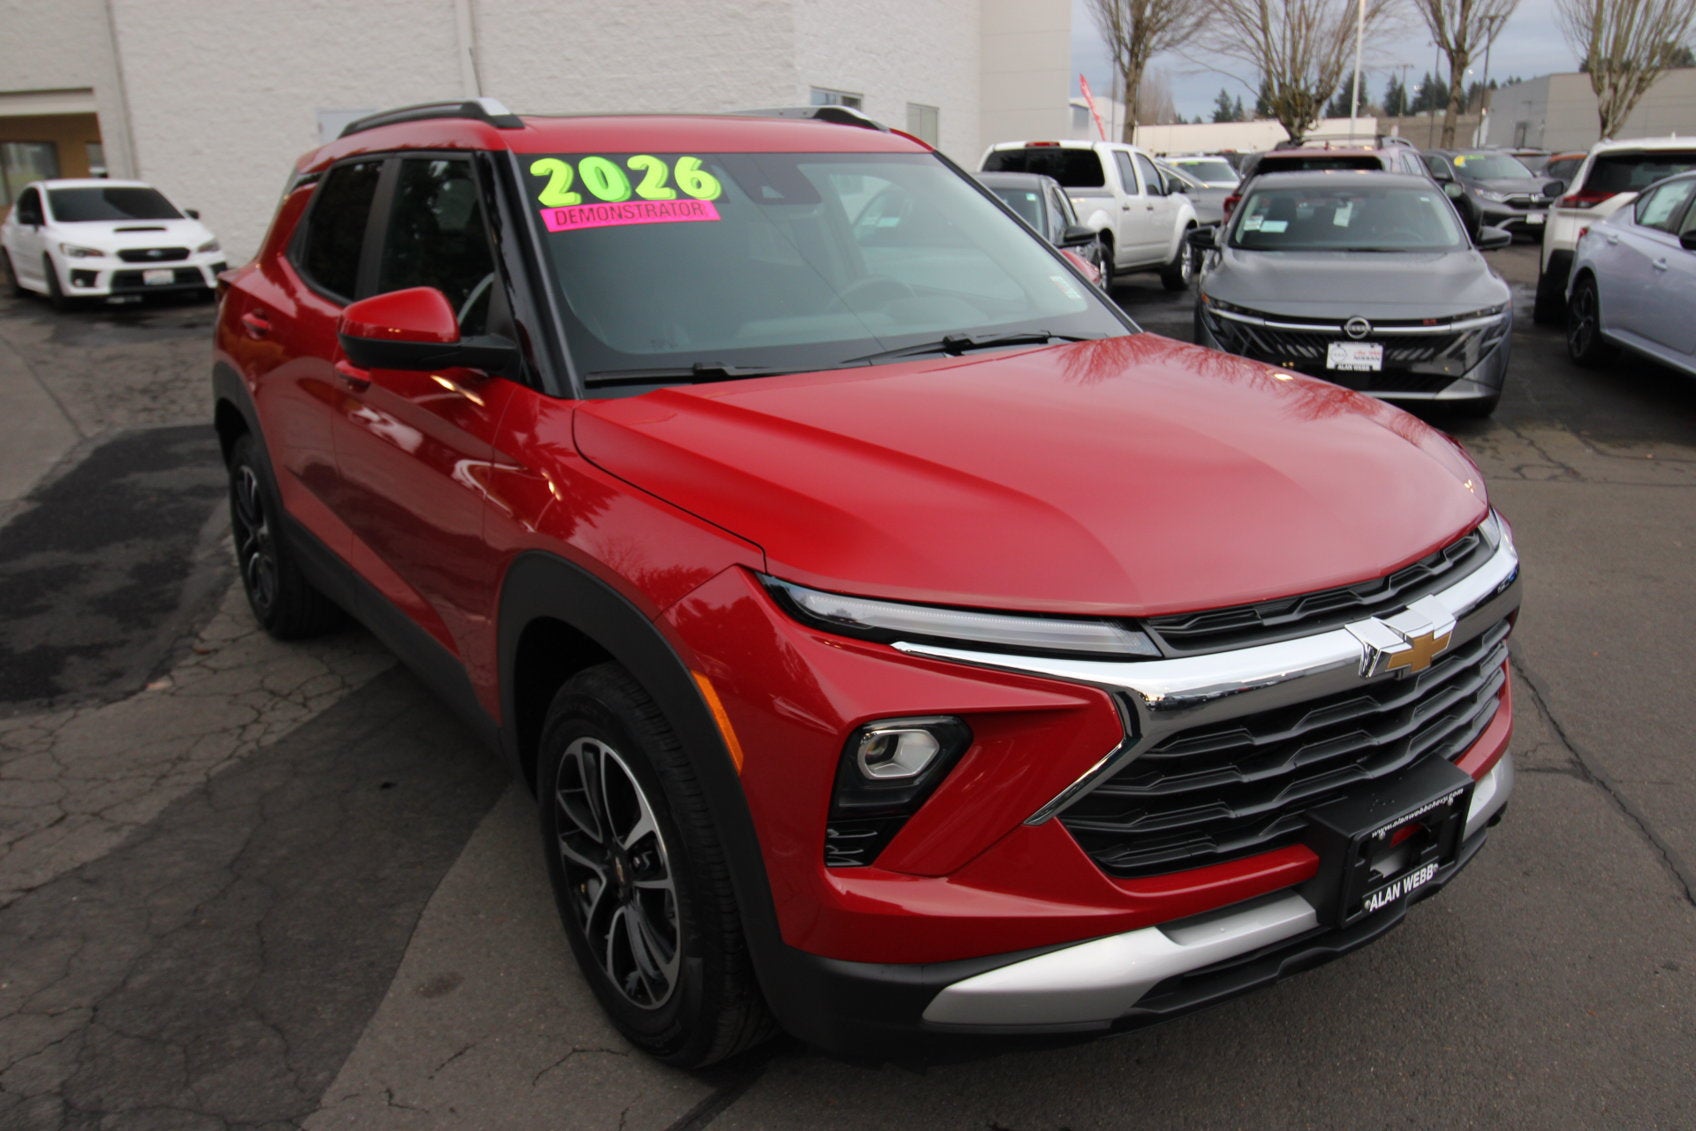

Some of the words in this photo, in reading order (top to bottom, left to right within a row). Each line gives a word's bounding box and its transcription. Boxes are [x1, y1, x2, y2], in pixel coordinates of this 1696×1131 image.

[530, 154, 722, 207] 2026
[554, 202, 705, 226] DEMONSTRATOR
[1369, 882, 1401, 912] ALAN
[1403, 863, 1434, 894] WEBB
